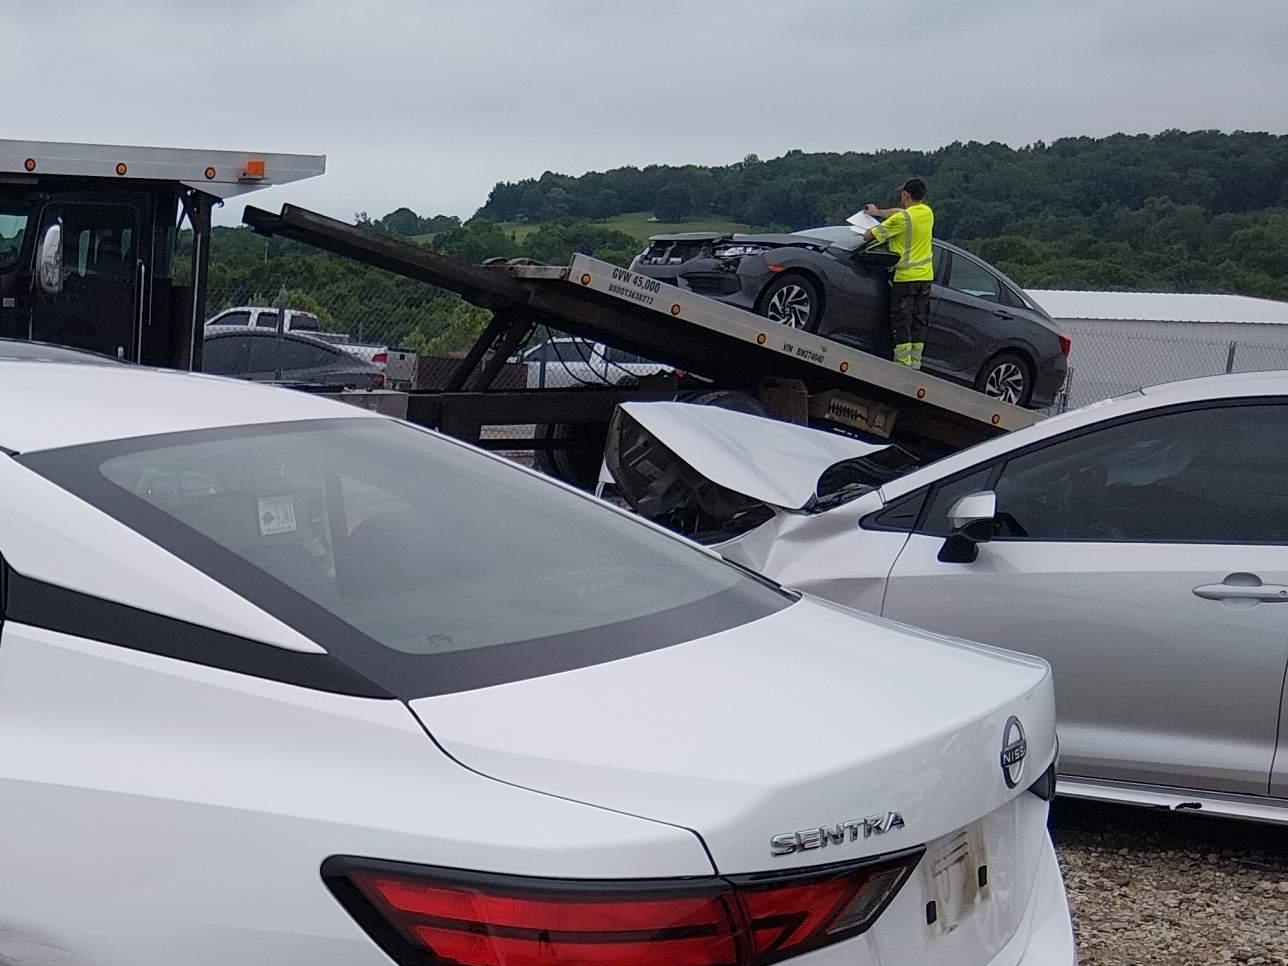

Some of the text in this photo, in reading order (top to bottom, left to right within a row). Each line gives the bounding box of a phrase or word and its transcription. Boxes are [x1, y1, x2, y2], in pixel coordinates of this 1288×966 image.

[612, 267, 661, 294] GVW 45,000
[1003, 745, 1026, 765] NISS
[770, 811, 905, 857] SENTRA
